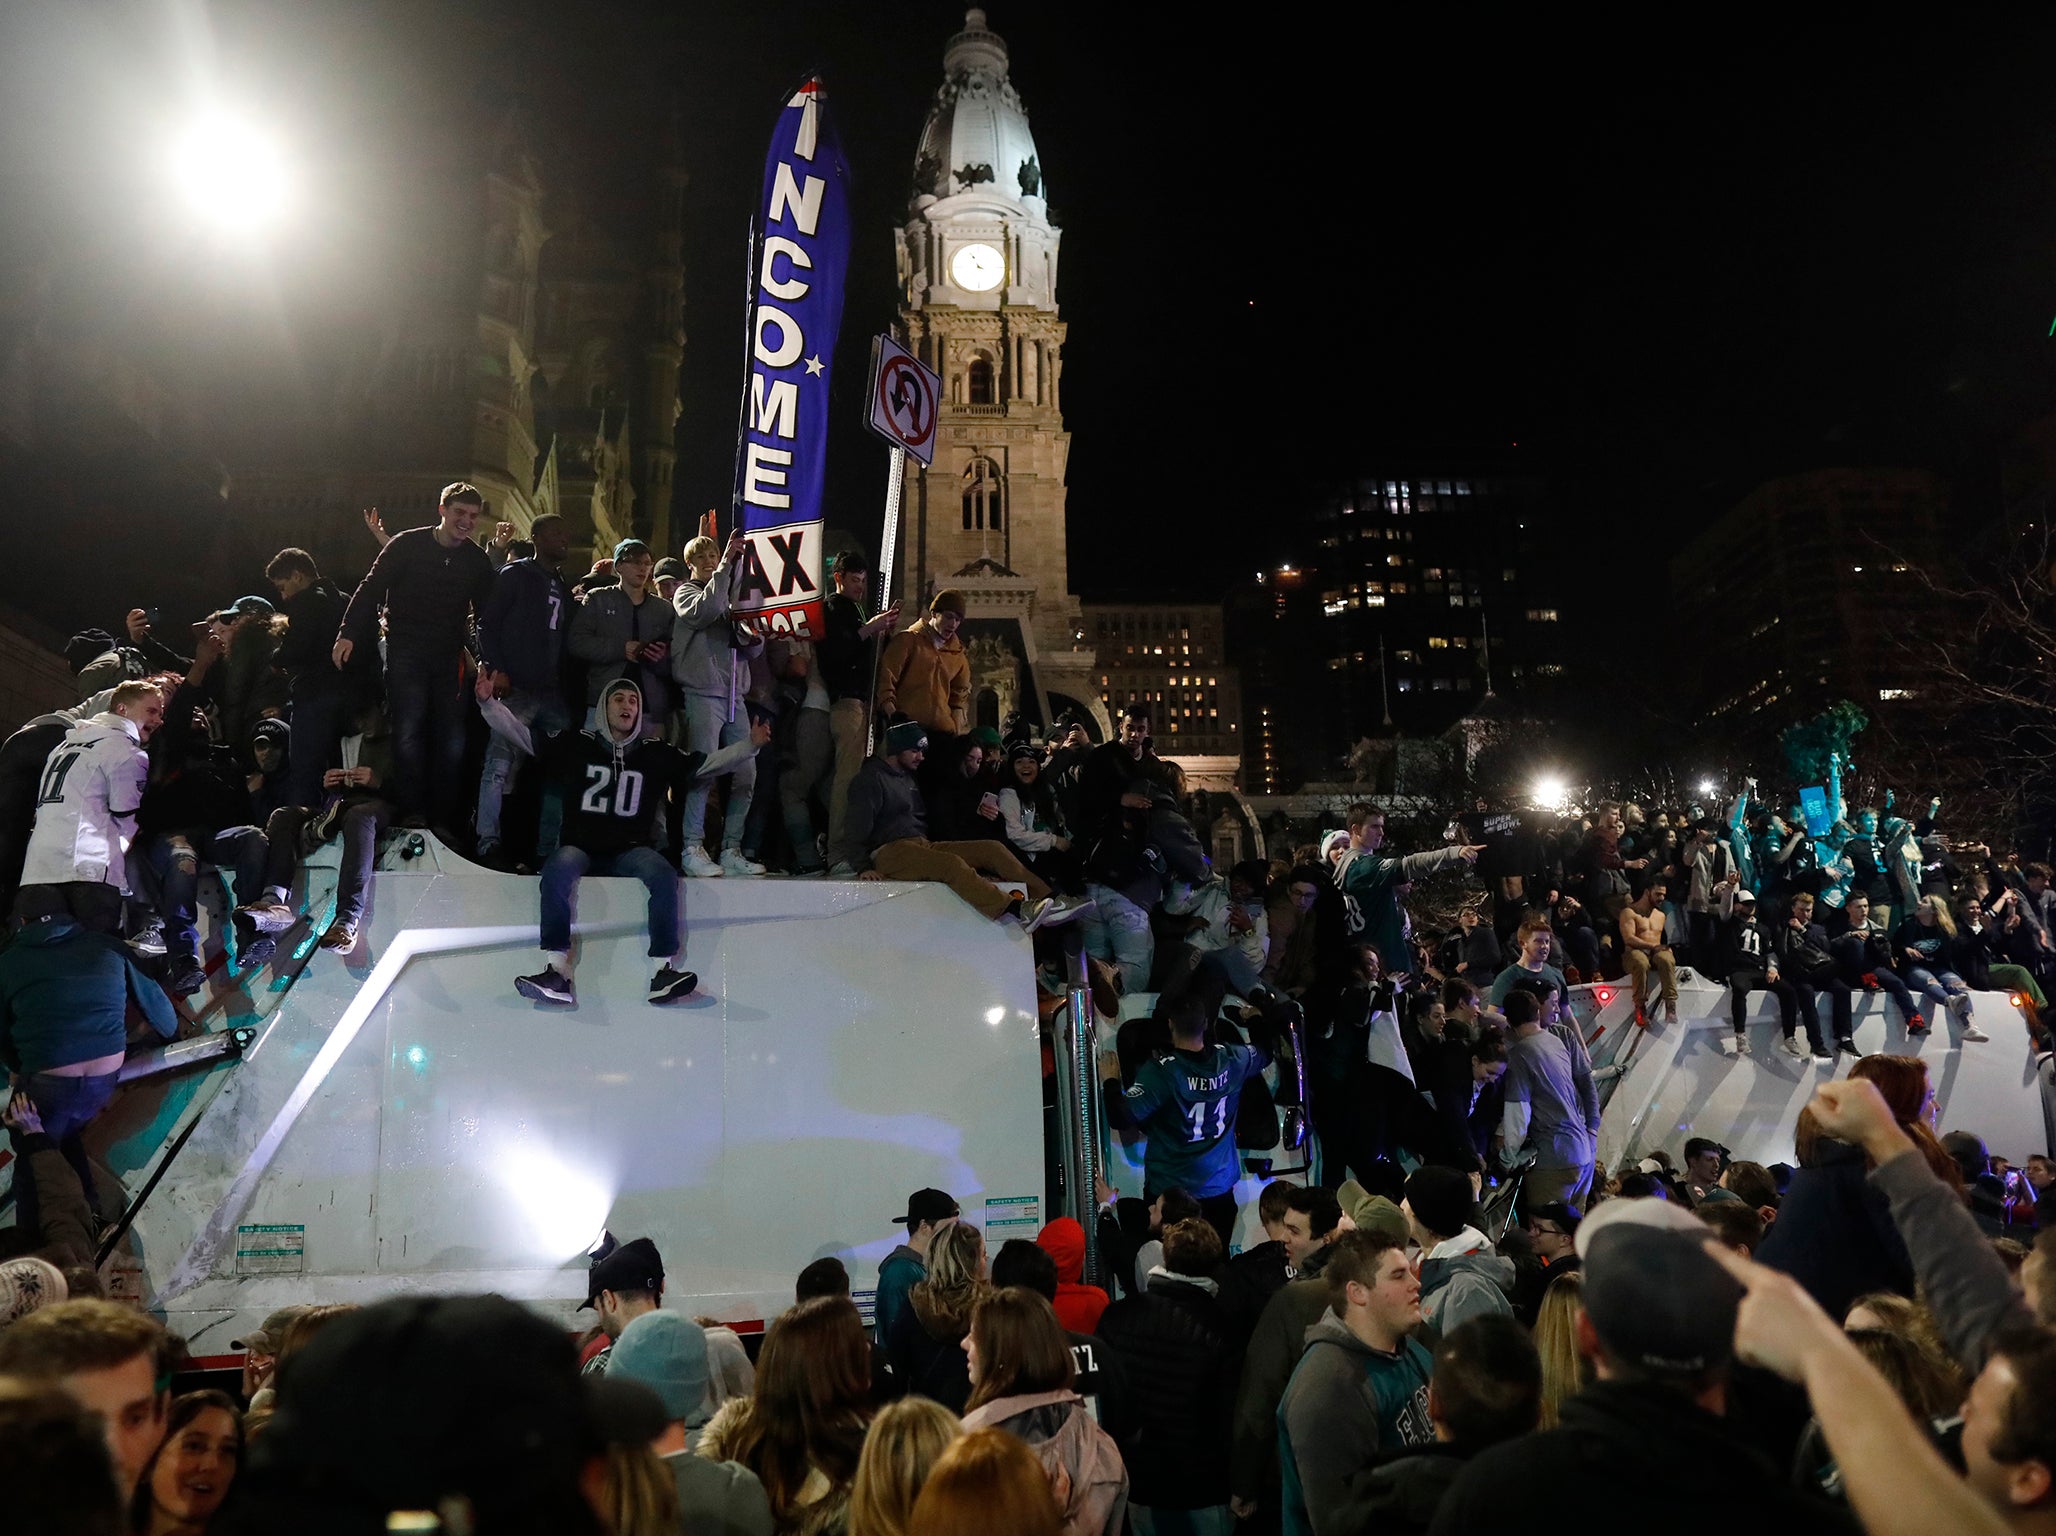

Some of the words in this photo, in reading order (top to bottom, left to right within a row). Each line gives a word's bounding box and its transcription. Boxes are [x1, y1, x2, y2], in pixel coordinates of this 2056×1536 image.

[744, 95, 826, 508] INCOME
[738, 531, 817, 601] AX
[549, 595, 560, 630] 7
[581, 764, 643, 817] 20
[1483, 814, 1511, 827] SUPER
[1496, 818, 1521, 832] BOWL
[1741, 928, 1760, 956] 11
[1187, 1070, 1228, 1091] WENTZ
[1187, 1096, 1228, 1142] 11
[1069, 1344, 1099, 1375] TZ
